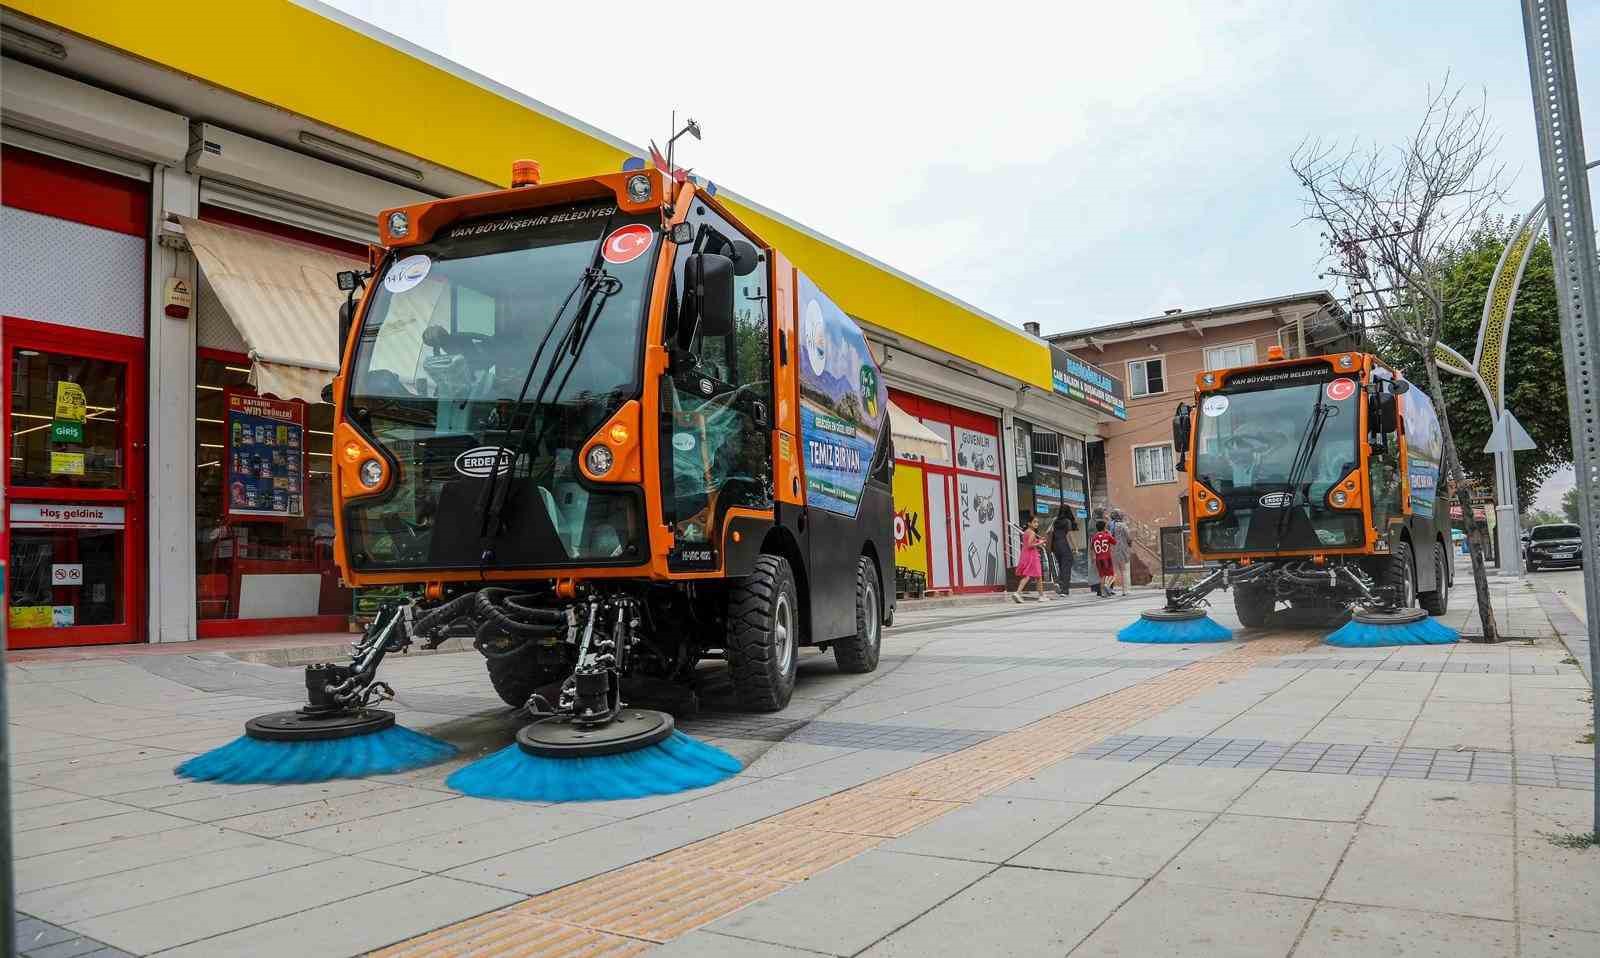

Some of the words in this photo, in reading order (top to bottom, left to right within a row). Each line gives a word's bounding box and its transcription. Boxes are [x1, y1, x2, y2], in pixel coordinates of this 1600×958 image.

[450, 227, 474, 238] VAN
[475, 216, 548, 235] BÜYÜKŞEHİR
[809, 440, 834, 466] TEMİZ
[40, 508, 60, 519] Hoş
[63, 508, 104, 520] geldiniz
[961, 482, 970, 529] TAZE
[893, 511, 921, 546] OK
[1094, 539, 1109, 554] 65
